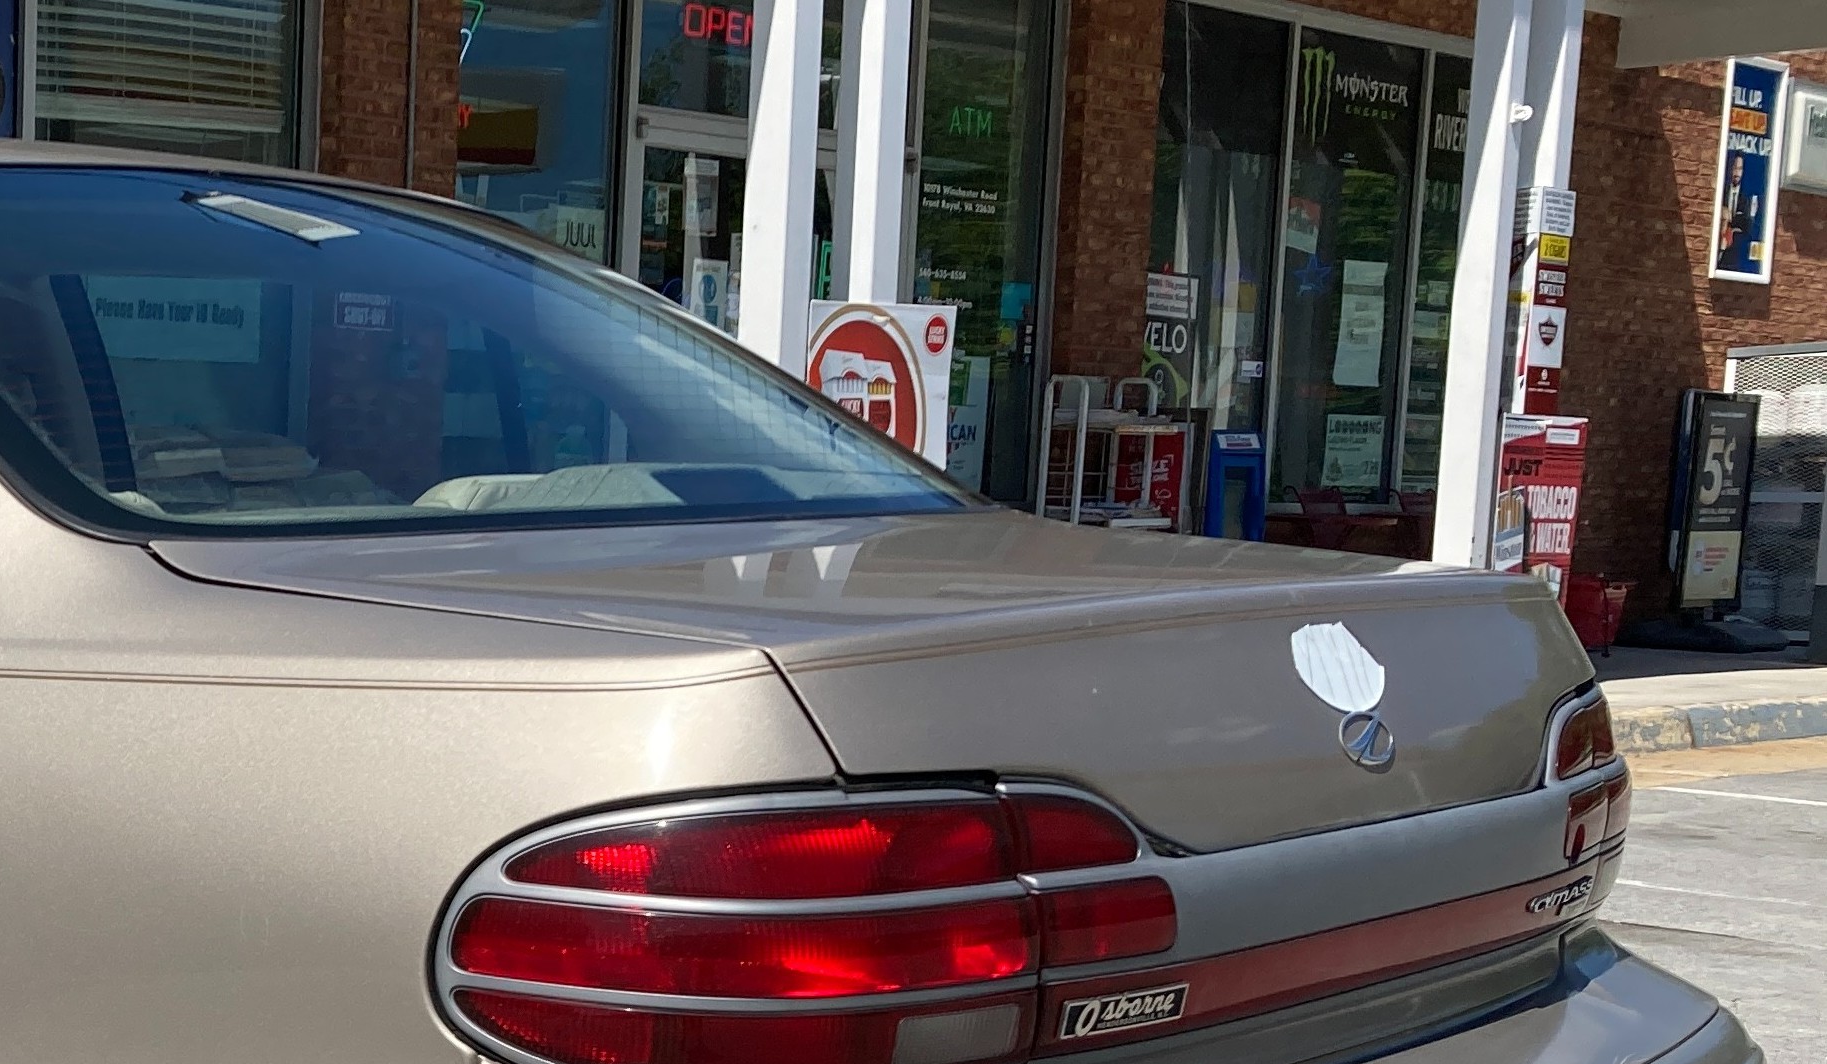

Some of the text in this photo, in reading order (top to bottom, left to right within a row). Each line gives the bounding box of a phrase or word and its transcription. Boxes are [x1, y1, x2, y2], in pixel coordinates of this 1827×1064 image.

[1335, 72, 1409, 107] MONSTER
[949, 105, 992, 138] ATM
[563, 222, 596, 249] JUUL
[96, 297, 134, 320] Please
[137, 299, 164, 320] Have
[169, 301, 194, 323] Your
[212, 304, 244, 328] Ready
[1504, 457, 1544, 477] JUST
[1527, 485, 1578, 520] TOBACCO
[1075, 992, 1175, 1037] Osborne
